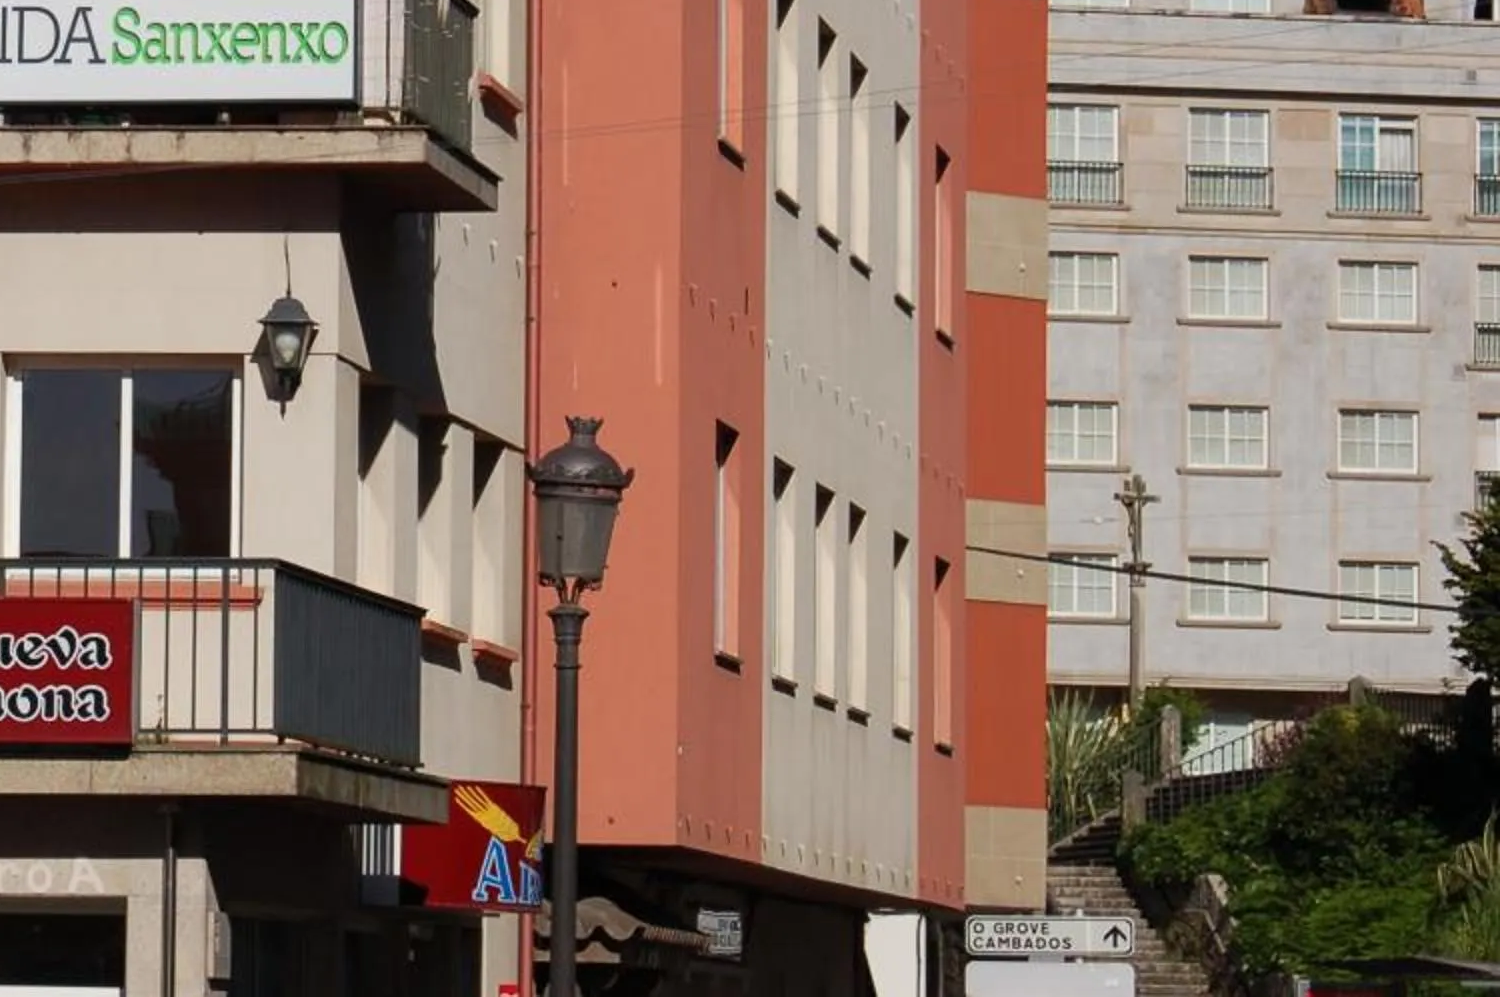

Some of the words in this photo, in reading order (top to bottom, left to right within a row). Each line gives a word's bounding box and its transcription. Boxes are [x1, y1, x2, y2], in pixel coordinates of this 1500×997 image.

[111, 6, 349, 66] Sanxenxo
[972, 921, 986, 935] O
[993, 921, 1050, 935] GROVE
[972, 936, 1073, 950] CAMBADOS
